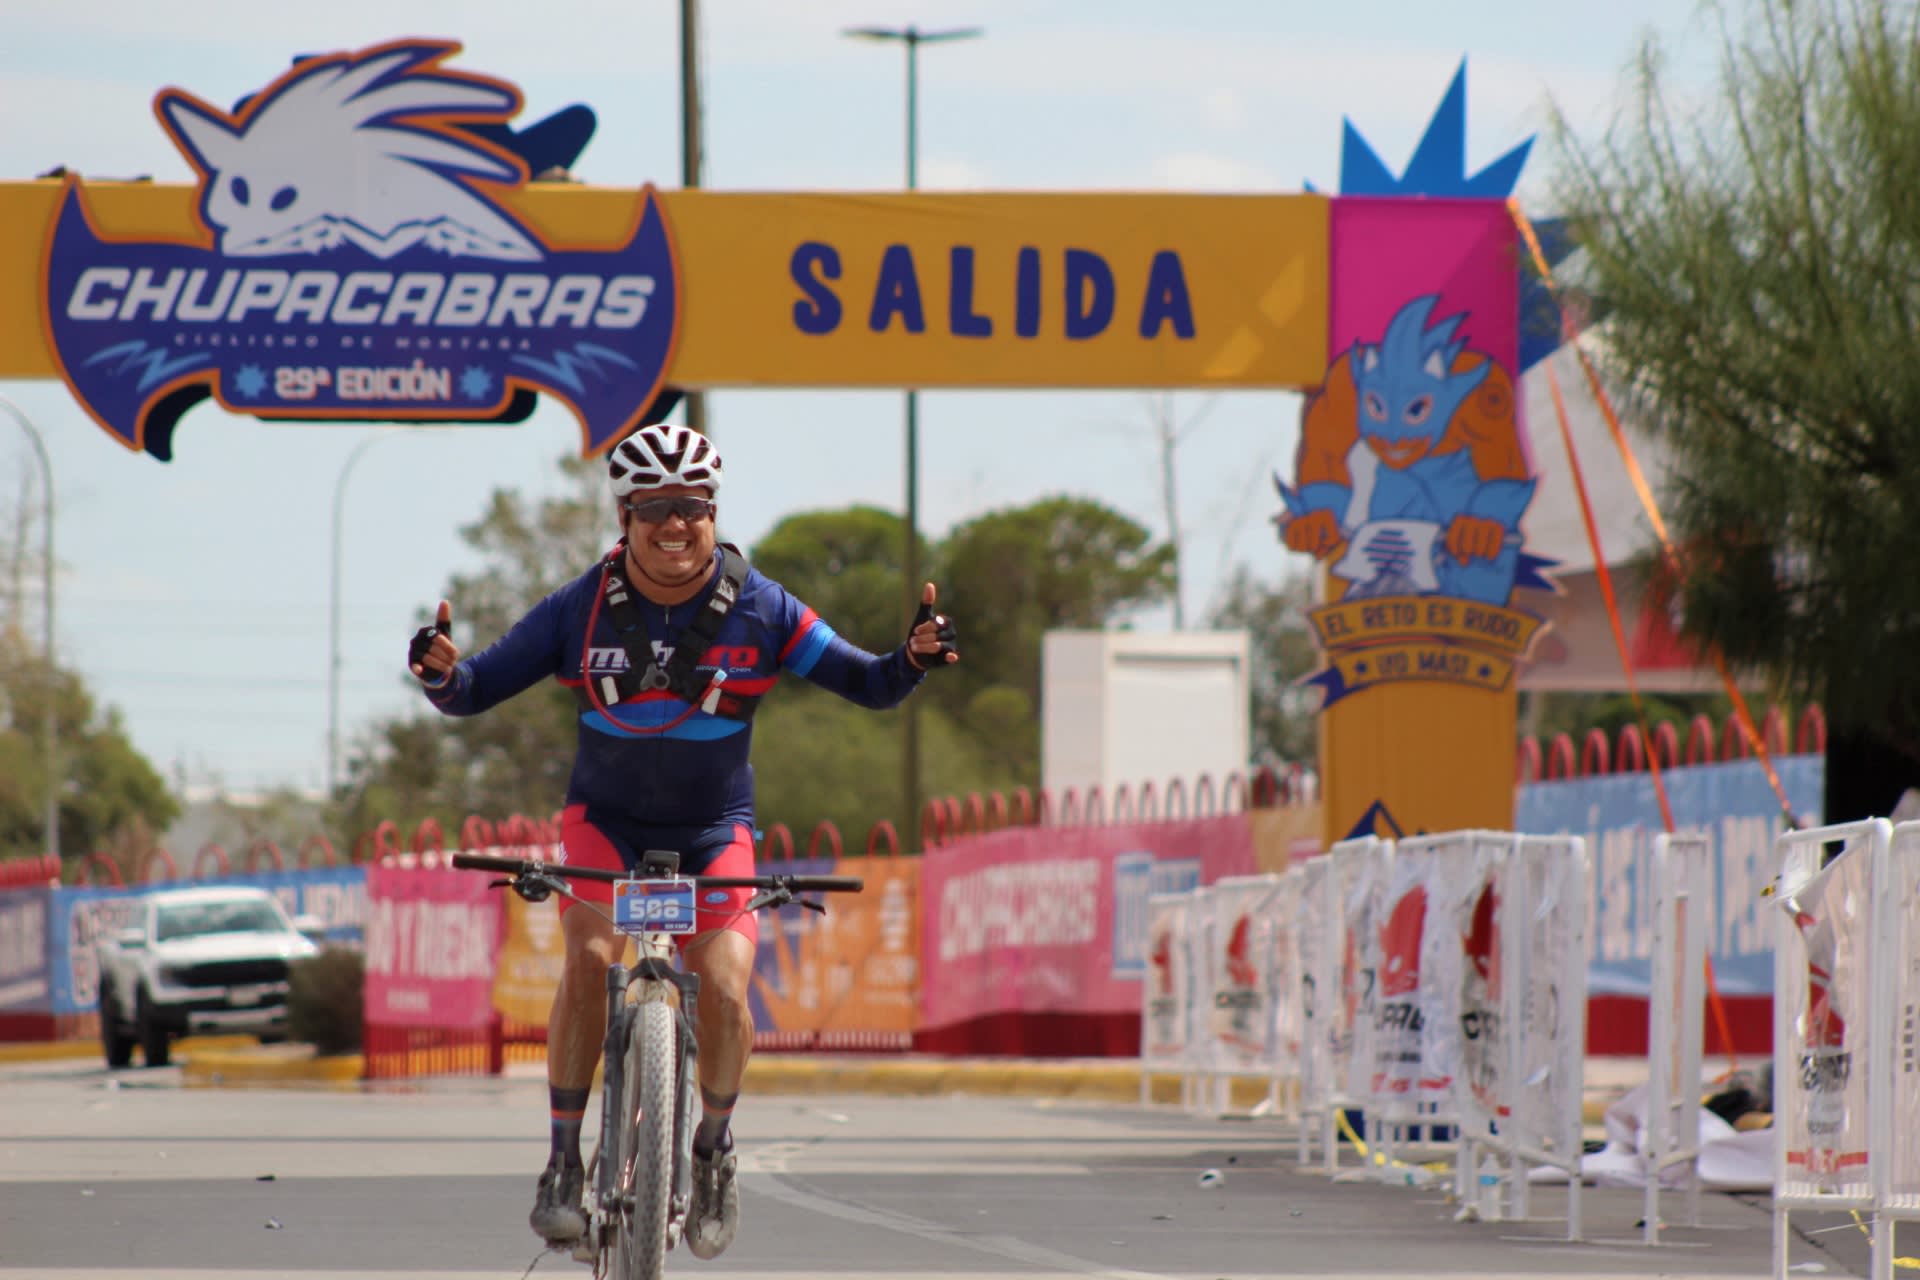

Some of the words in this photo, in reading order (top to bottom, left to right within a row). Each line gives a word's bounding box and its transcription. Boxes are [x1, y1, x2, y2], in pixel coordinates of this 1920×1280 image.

[66, 267, 656, 328] CHUPACABRAS
[790, 241, 1196, 340] SALIDA
[340, 336, 373, 348] DE
[336, 358, 451, 400] EDICIÓN
[1323, 612, 1353, 638] EL
